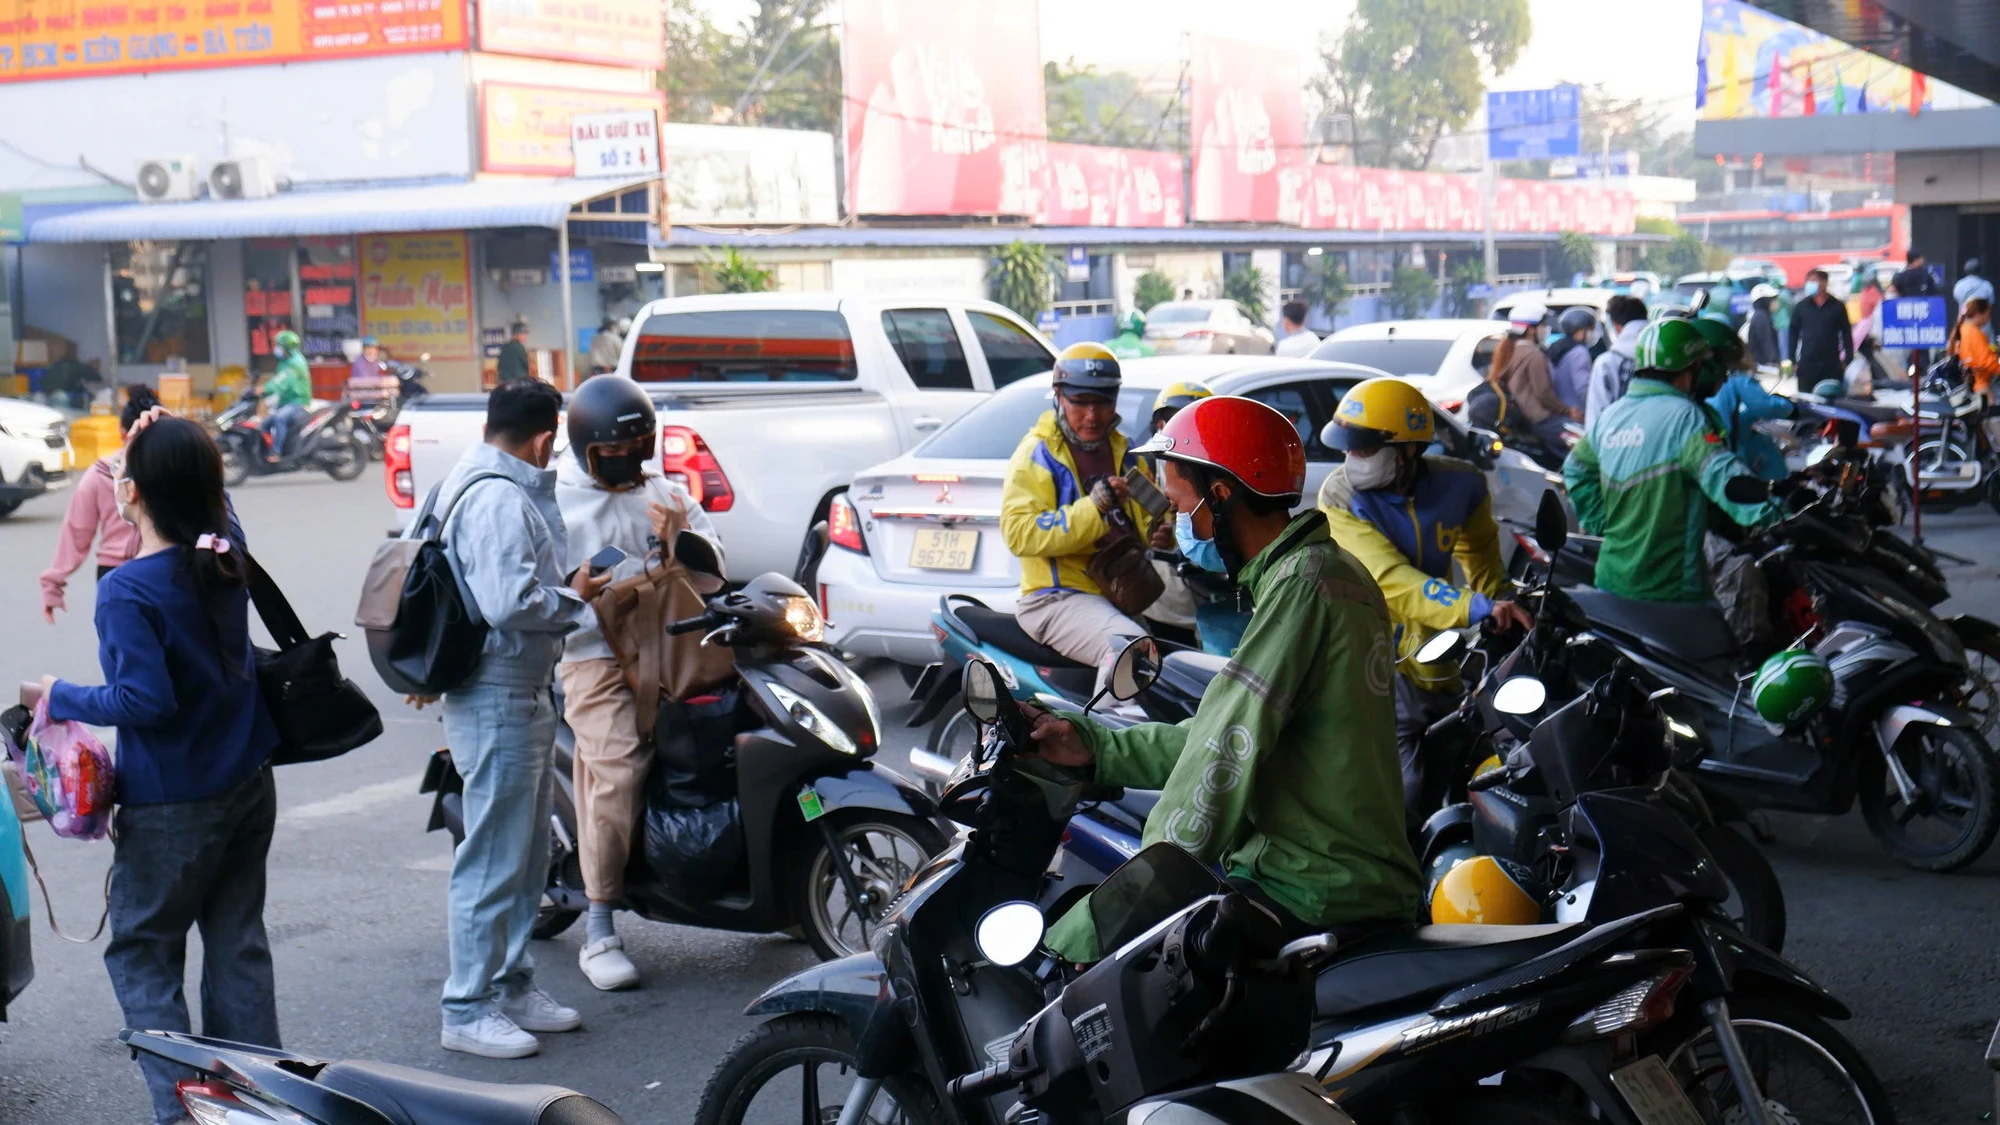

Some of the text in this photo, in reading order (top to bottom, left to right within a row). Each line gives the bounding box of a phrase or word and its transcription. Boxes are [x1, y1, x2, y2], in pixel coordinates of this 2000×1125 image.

[634, 121, 650, 137] XE
[1085, 359, 1104, 371] be
[1405, 406, 1428, 432] be
[1602, 423, 1645, 449] Grab
[931, 531, 960, 548] 51H
[1165, 724, 1254, 852] Grab
